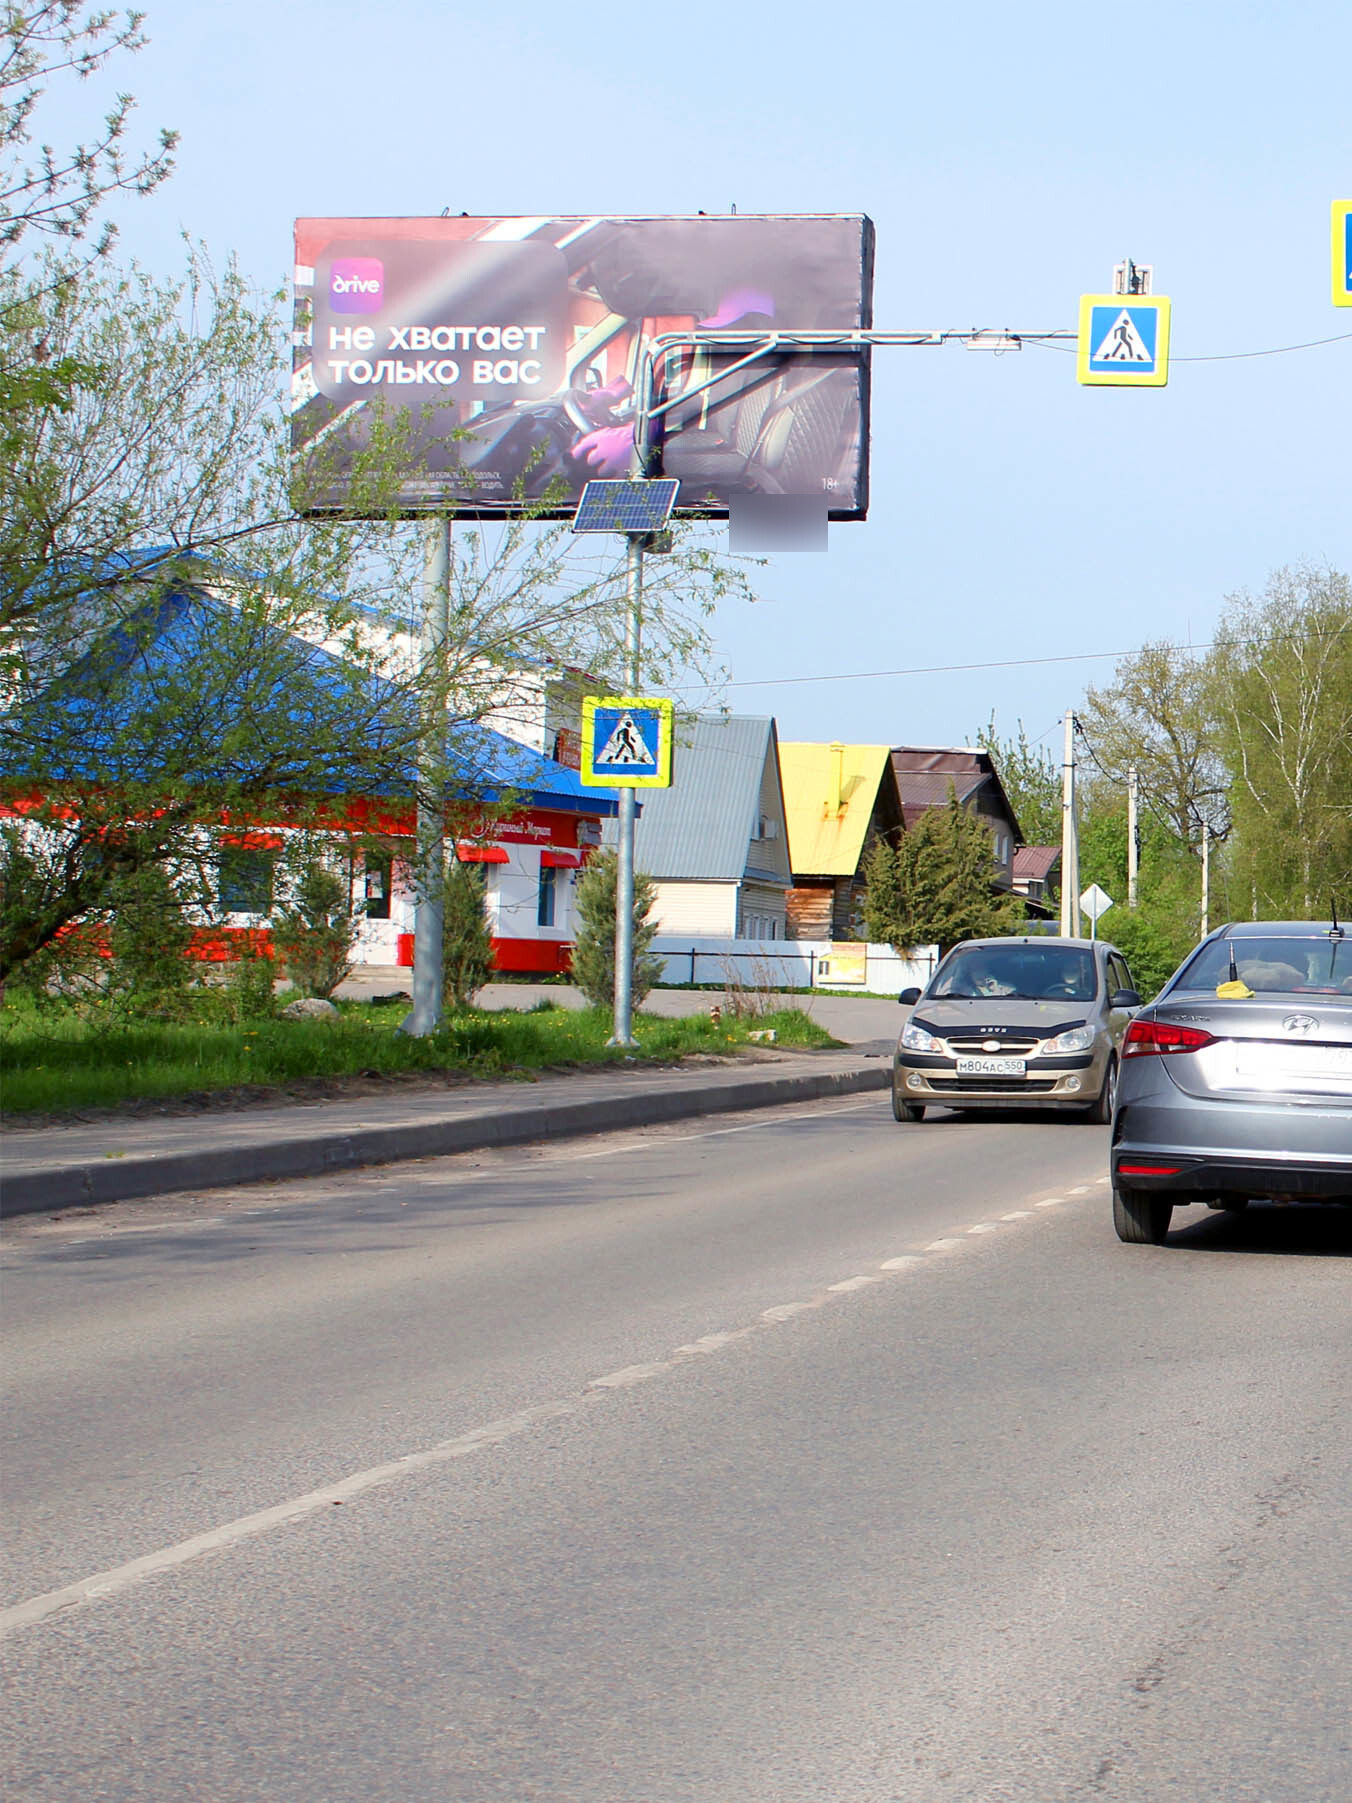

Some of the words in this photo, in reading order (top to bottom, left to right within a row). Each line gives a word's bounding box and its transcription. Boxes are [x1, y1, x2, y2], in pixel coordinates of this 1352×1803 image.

[328, 326, 376, 351] не
[388, 325, 546, 351] хватает
[328, 359, 460, 385] только
[472, 359, 543, 385] вас
